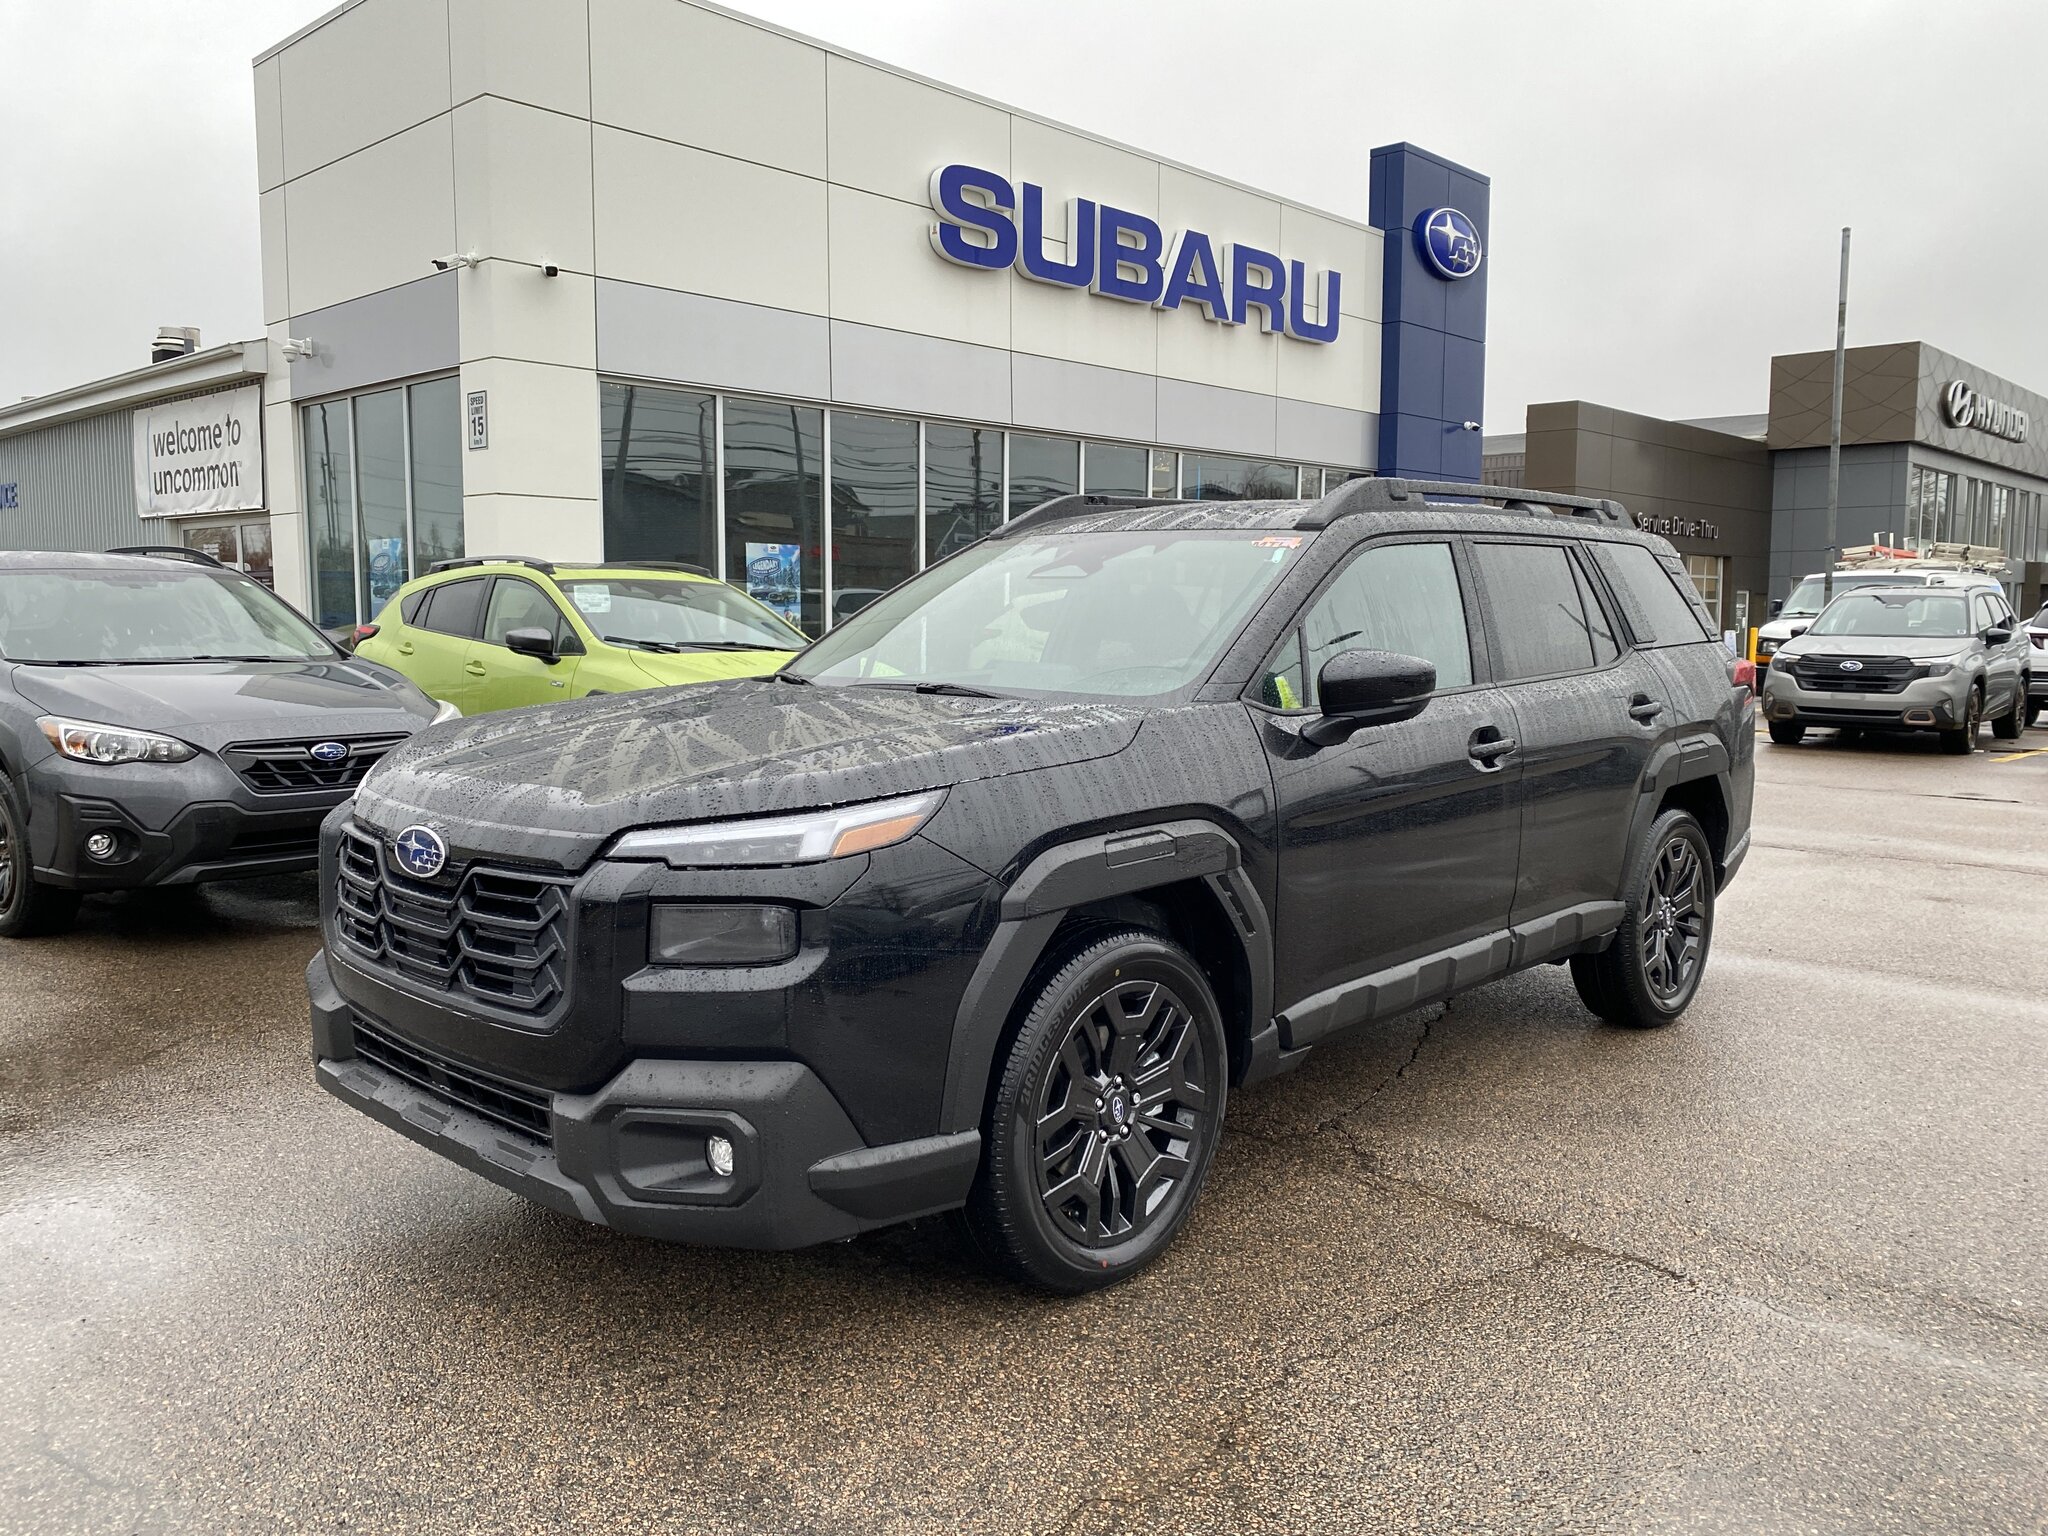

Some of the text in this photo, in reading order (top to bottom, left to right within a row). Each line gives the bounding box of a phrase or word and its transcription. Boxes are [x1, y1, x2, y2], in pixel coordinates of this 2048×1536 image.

[929, 164, 1341, 344] SUBARU
[470, 396, 484, 406] SPEED
[1975, 393, 2029, 440] HYUNDAI
[153, 413, 241, 457] welcome to
[472, 416, 484, 436] 15
[153, 461, 239, 495] uncommon
[1637, 512, 1719, 539] Service Drive-Thru
[1021, 980, 1090, 1105] BRIDGESTONE
